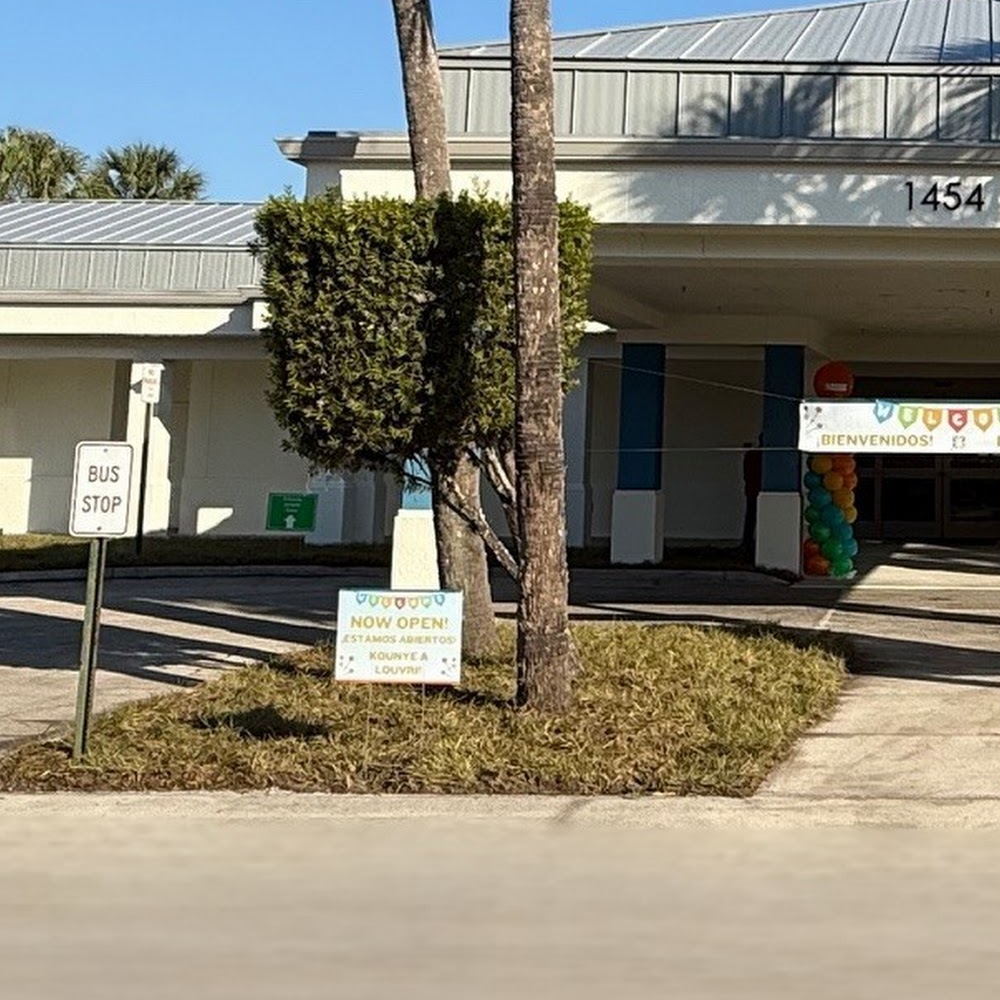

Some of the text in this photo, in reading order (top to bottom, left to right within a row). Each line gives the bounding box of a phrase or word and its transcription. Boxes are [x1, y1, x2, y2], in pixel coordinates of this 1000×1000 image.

[904, 181, 985, 212] 1454
[88, 465, 121, 483] BUS
[81, 495, 122, 513] STOP
[350, 615, 449, 630] NOW OPEN!
